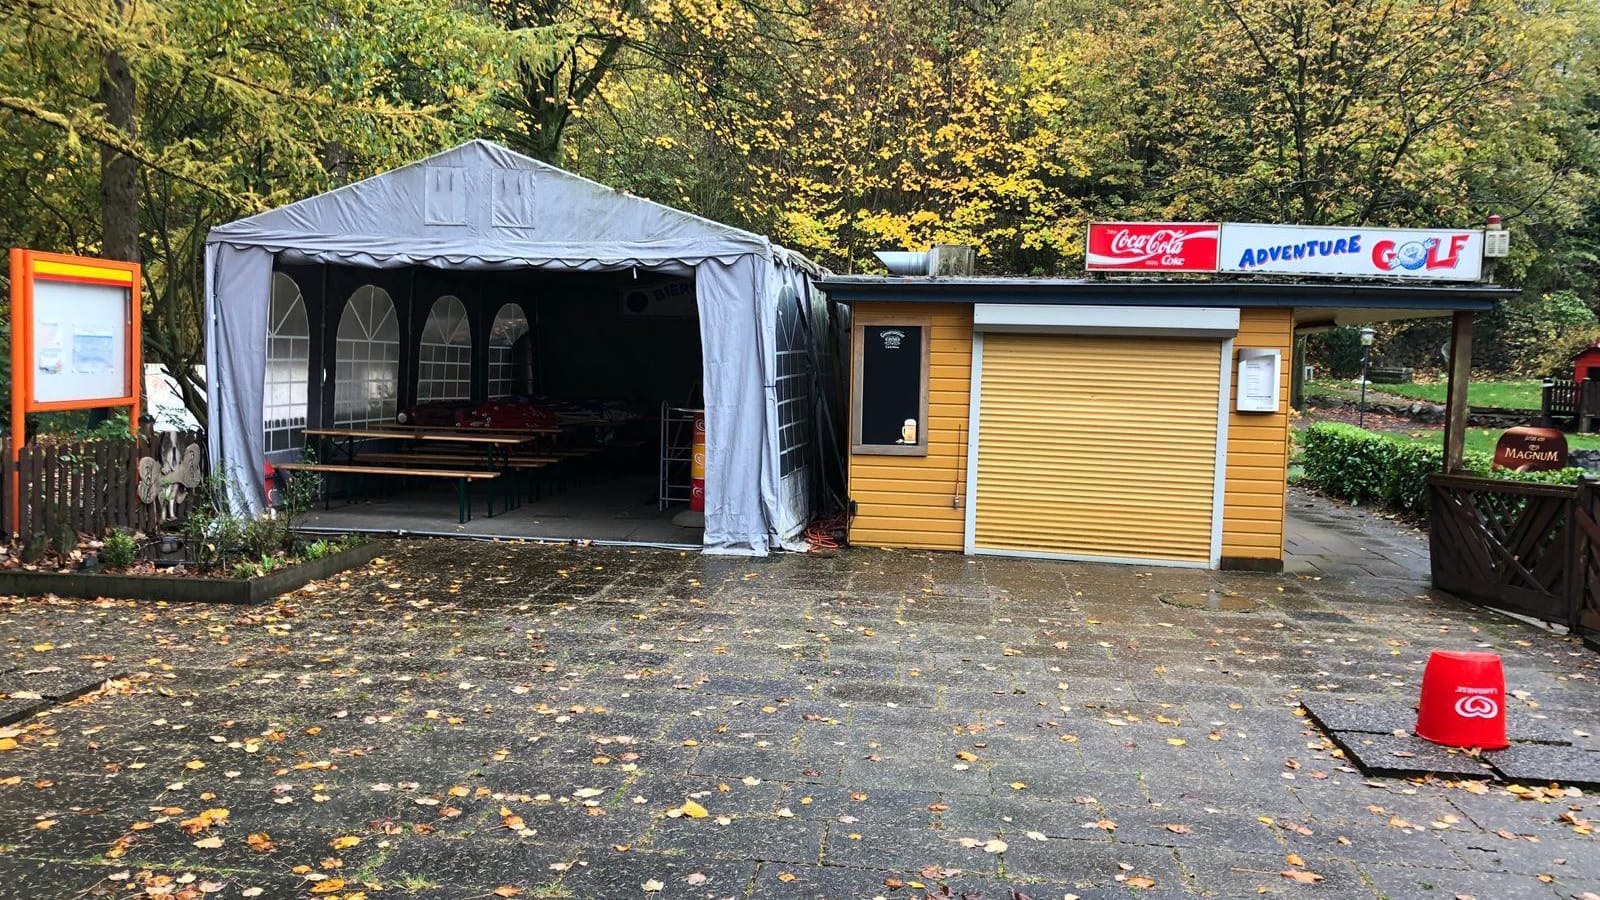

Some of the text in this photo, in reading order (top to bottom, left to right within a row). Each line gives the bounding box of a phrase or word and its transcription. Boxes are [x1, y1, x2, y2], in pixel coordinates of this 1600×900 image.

[1161, 254, 1185, 266] Coke
[1238, 234, 1471, 272] ADVENTURE GOLF
[653, 281, 696, 300] BIER
[1504, 447, 1558, 462] MAGNUM
